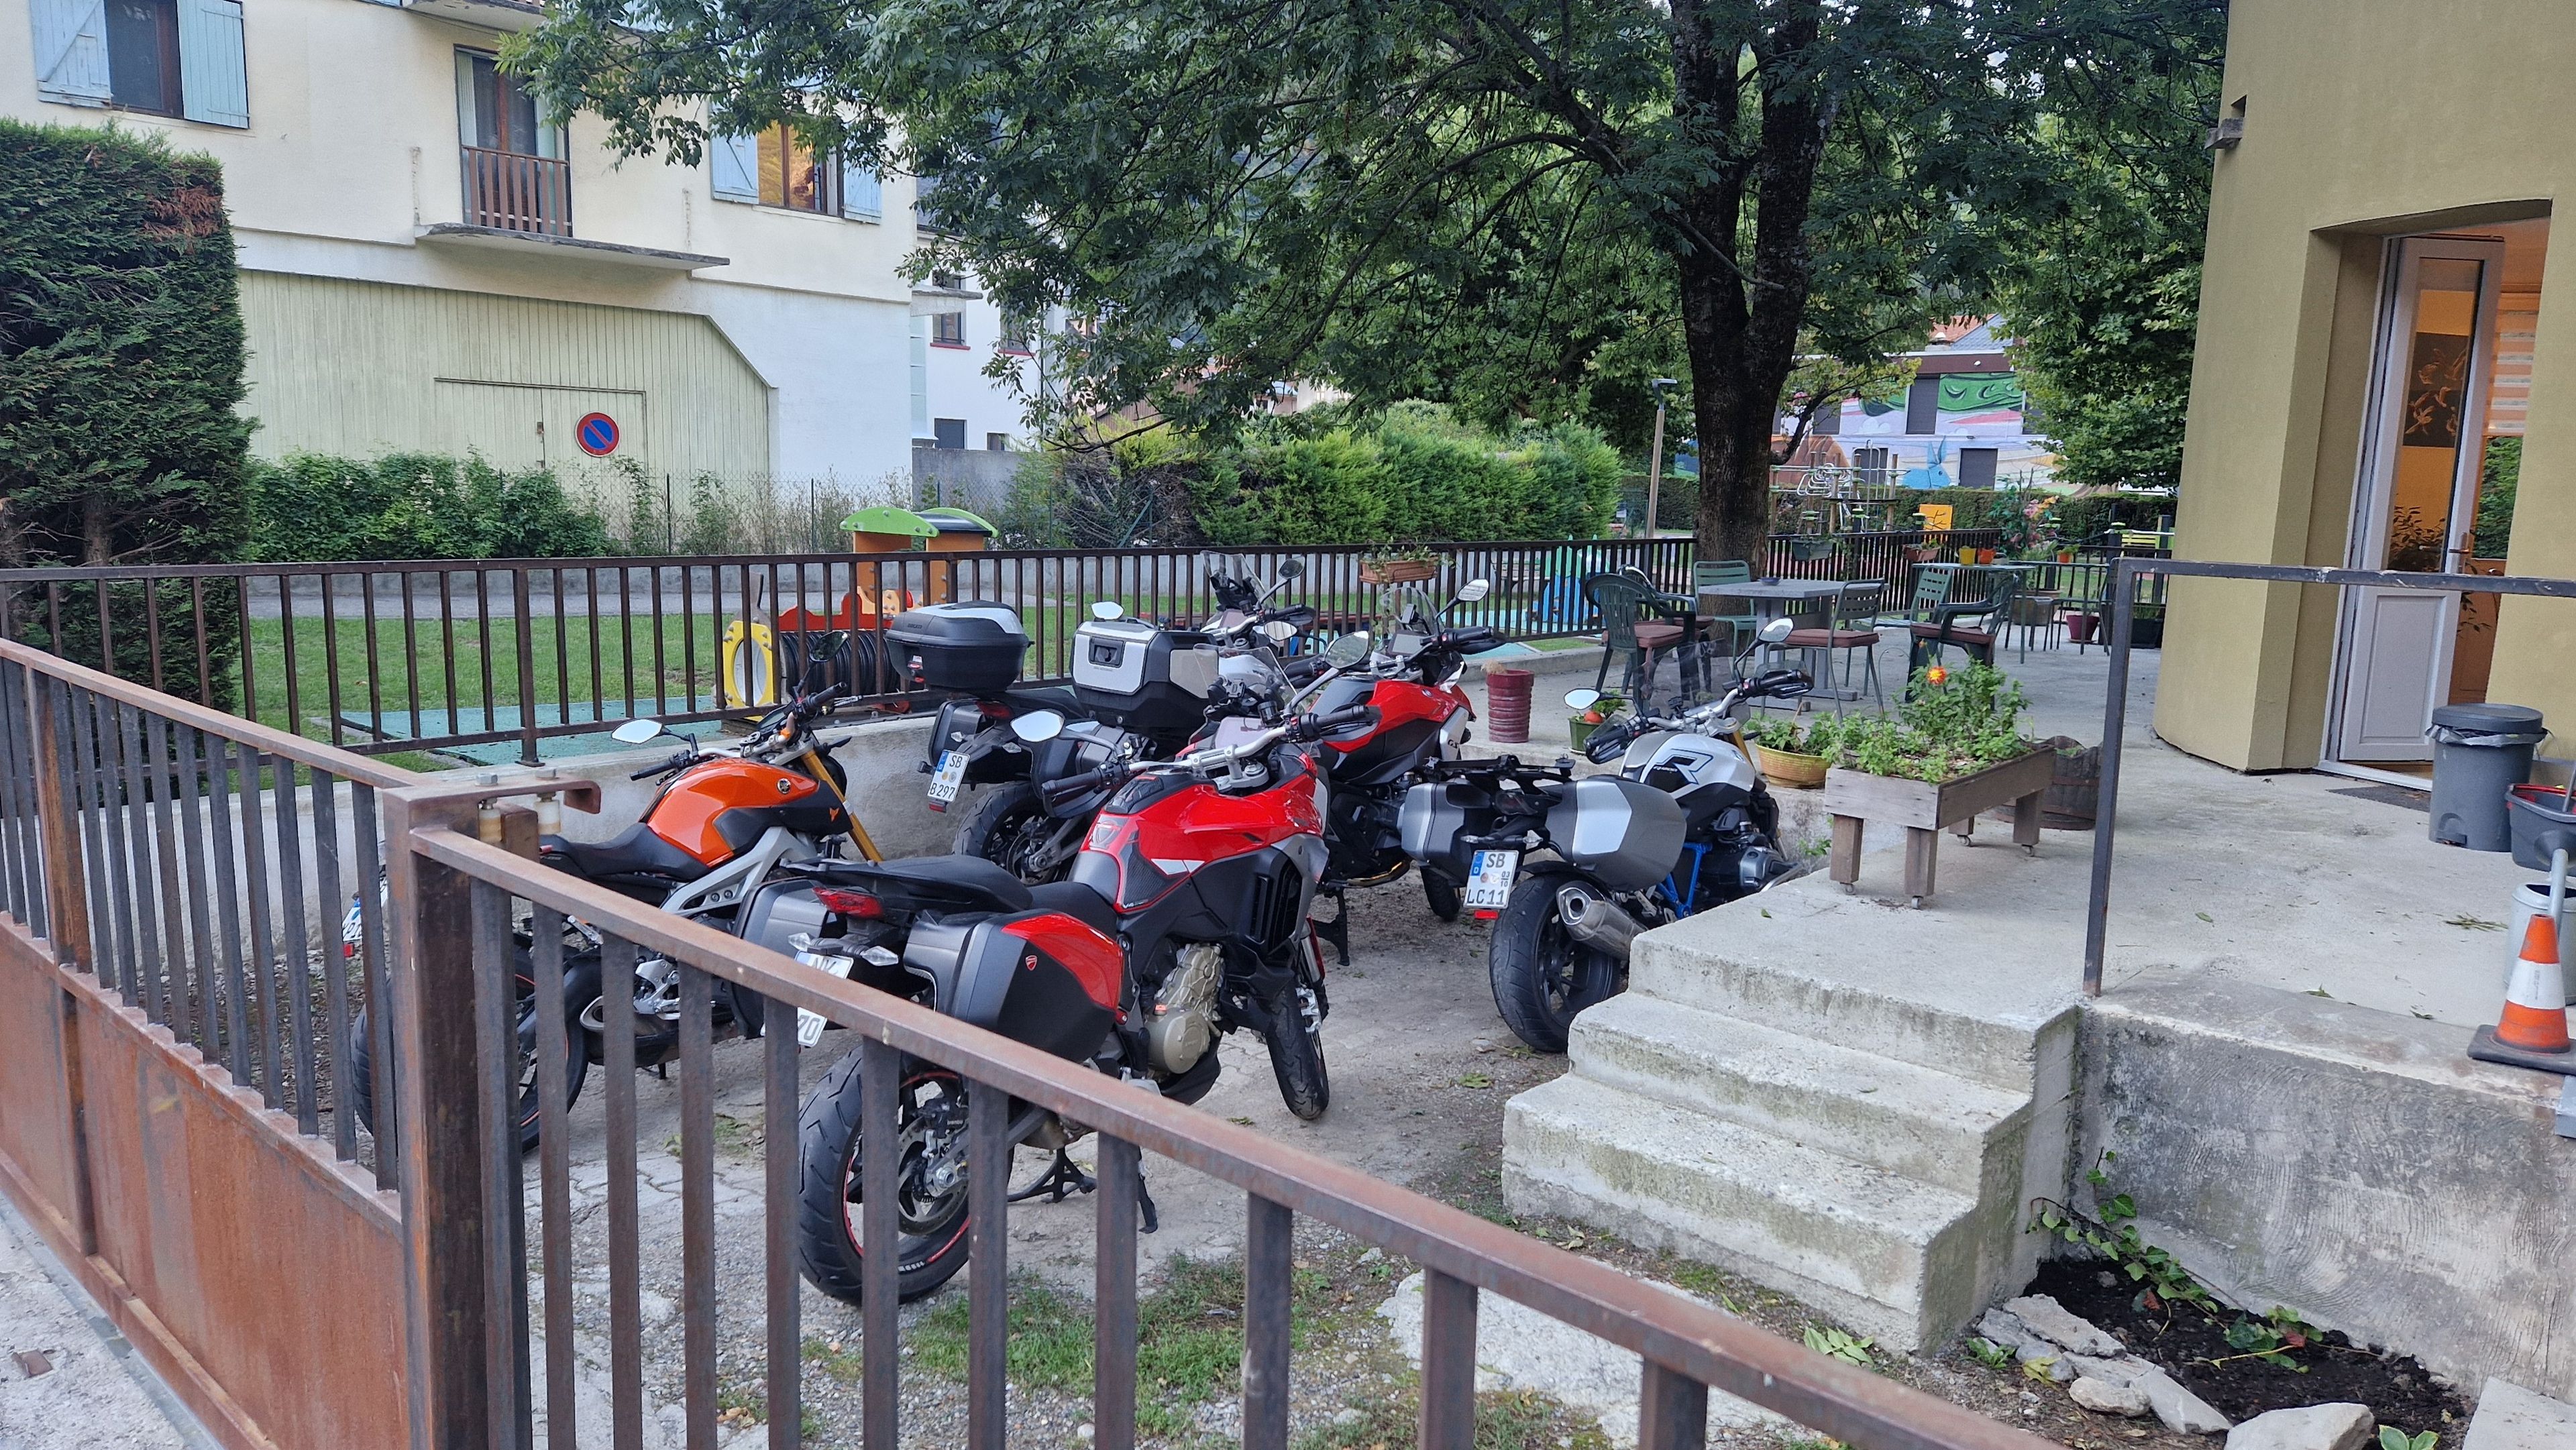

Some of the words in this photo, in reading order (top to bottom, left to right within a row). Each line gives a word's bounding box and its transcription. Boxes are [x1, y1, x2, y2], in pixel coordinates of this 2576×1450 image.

[949, 755, 963, 768] SB
[930, 783, 938, 795] B
[936, 784, 955, 799] 297
[1487, 853, 1505, 868] SB
[1467, 889, 1485, 904] LC
[1487, 889, 1505, 905] 11
